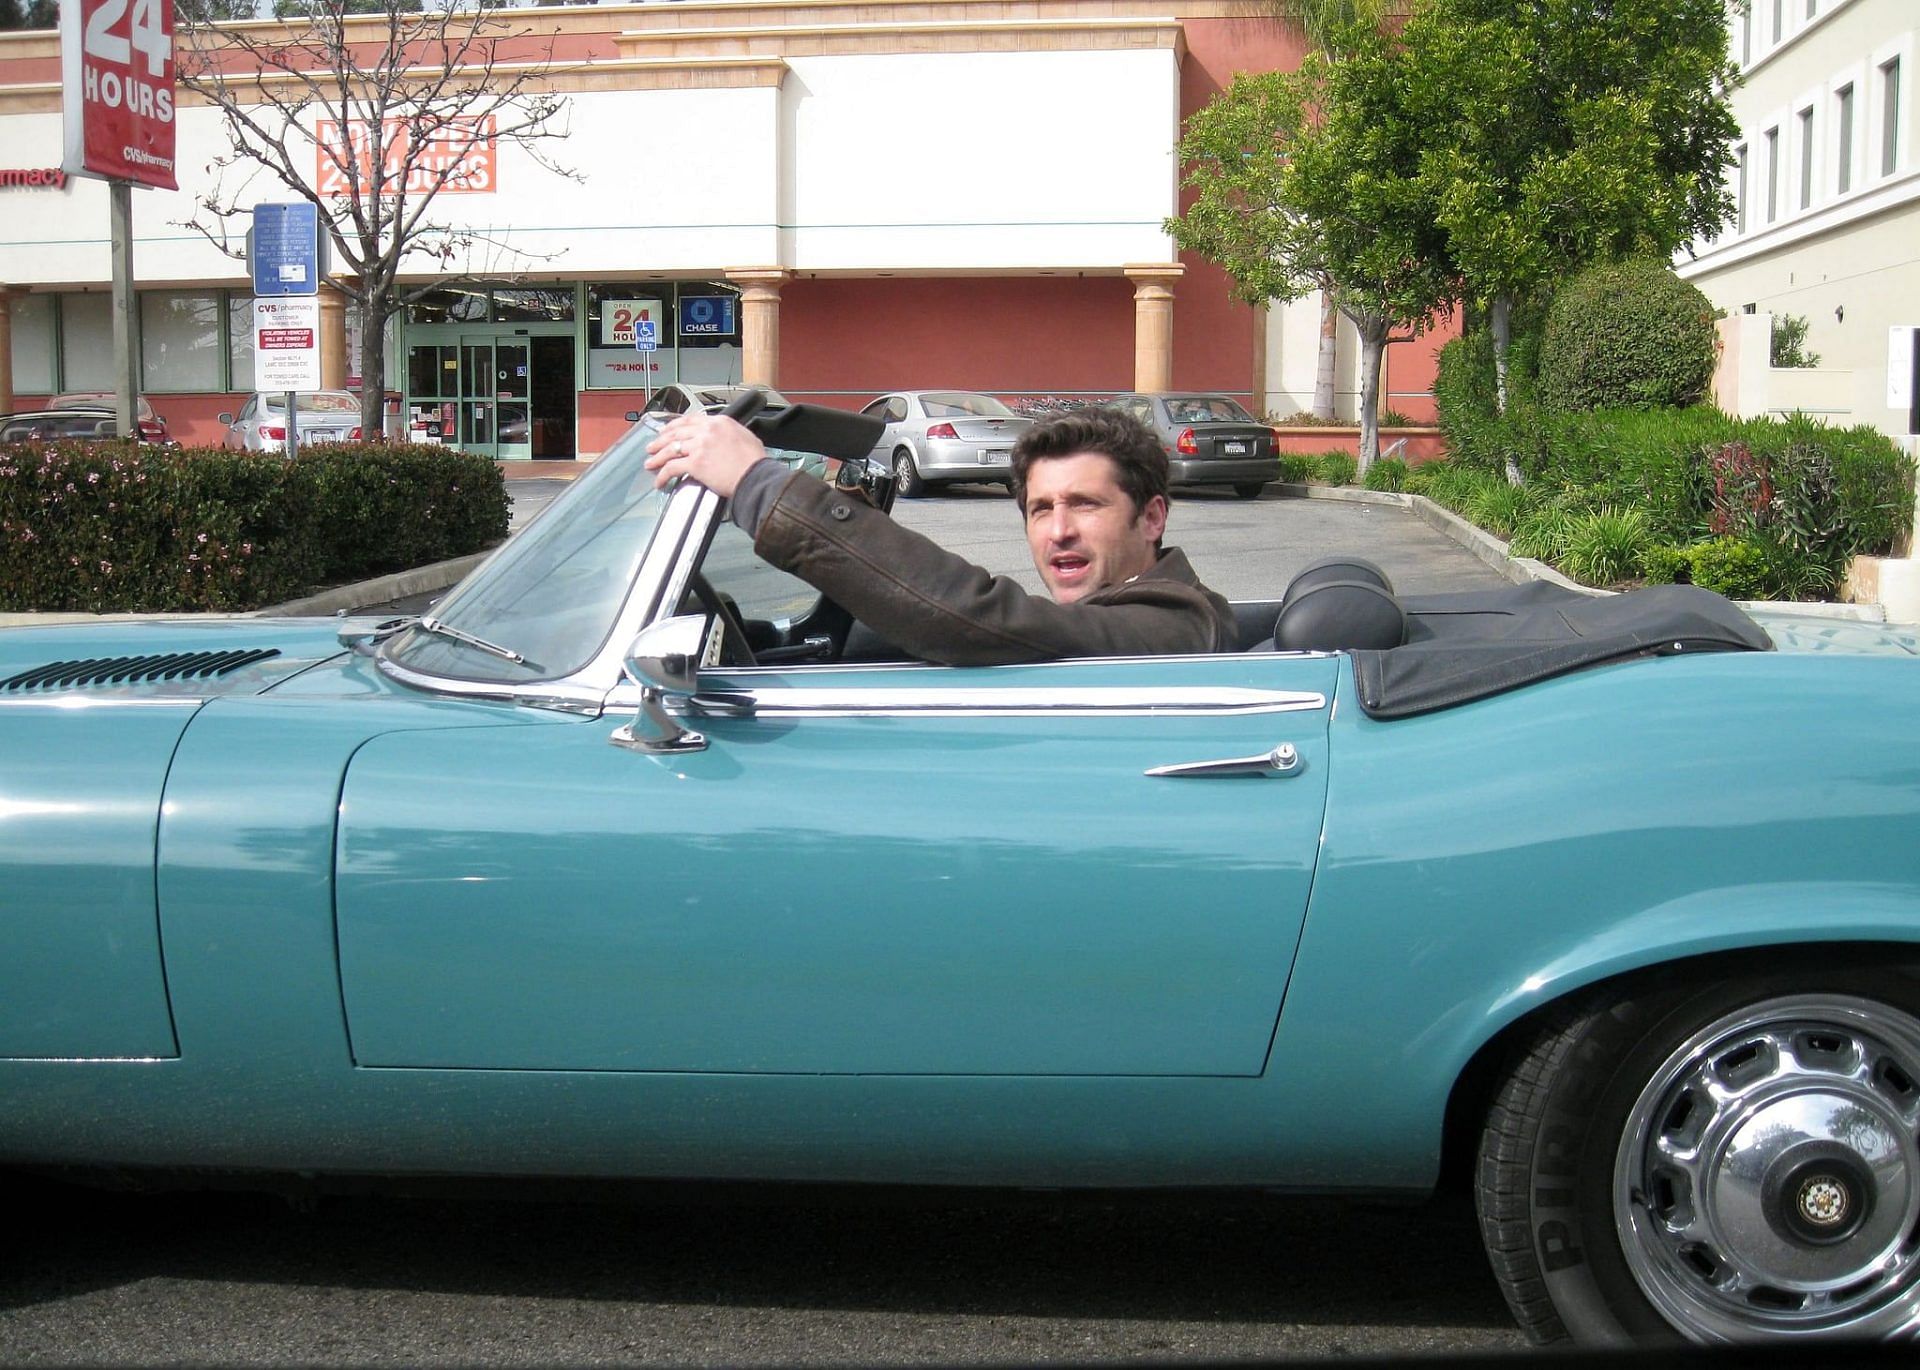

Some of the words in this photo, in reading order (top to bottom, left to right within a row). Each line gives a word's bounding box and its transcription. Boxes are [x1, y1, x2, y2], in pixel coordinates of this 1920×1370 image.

[86, 0, 172, 77] 24
[85, 66, 173, 123] HOURS
[322, 160, 367, 193] 24
[258, 304, 313, 313] CVS/pharmacy
[614, 309, 649, 332] 24
[685, 324, 718, 332] CHASE
[613, 333, 636, 341] HOU
